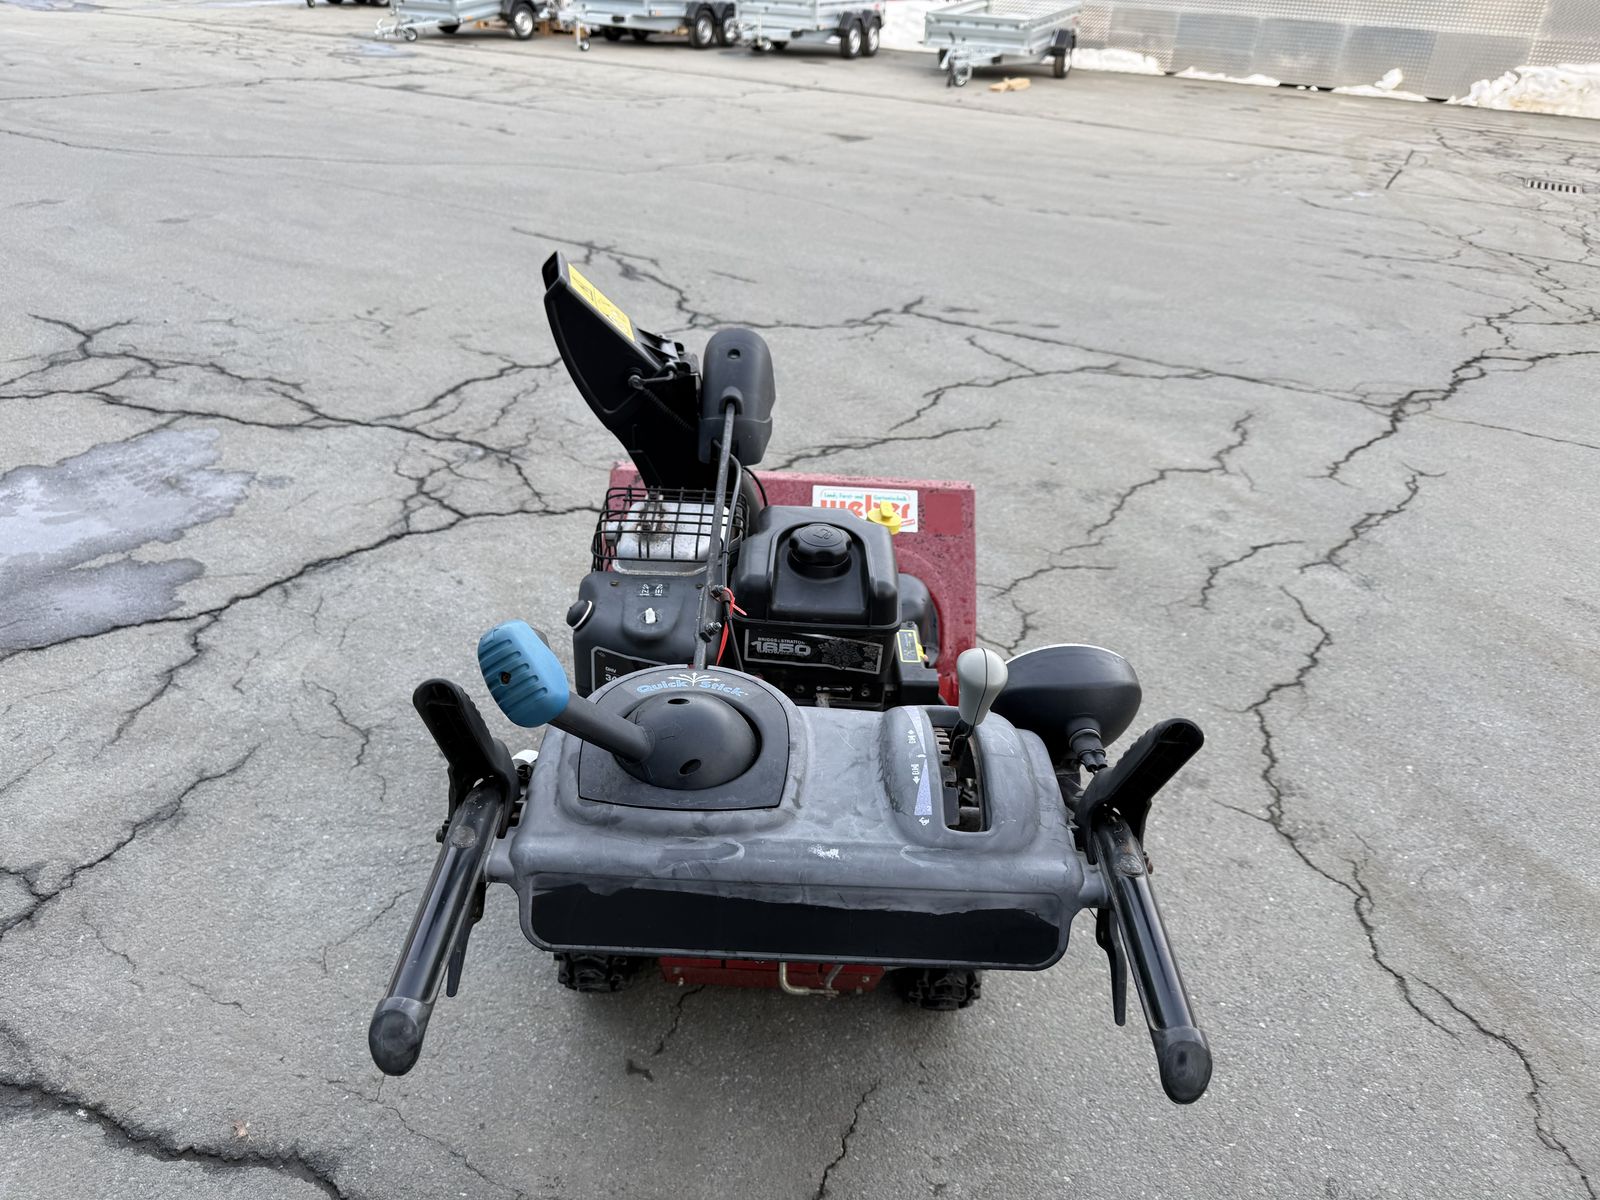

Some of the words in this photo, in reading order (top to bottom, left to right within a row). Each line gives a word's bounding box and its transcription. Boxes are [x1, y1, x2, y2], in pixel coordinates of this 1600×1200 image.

[751, 640, 811, 656] 1650
[636, 679, 689, 694] Quick
[699, 680, 745, 697] Stick
